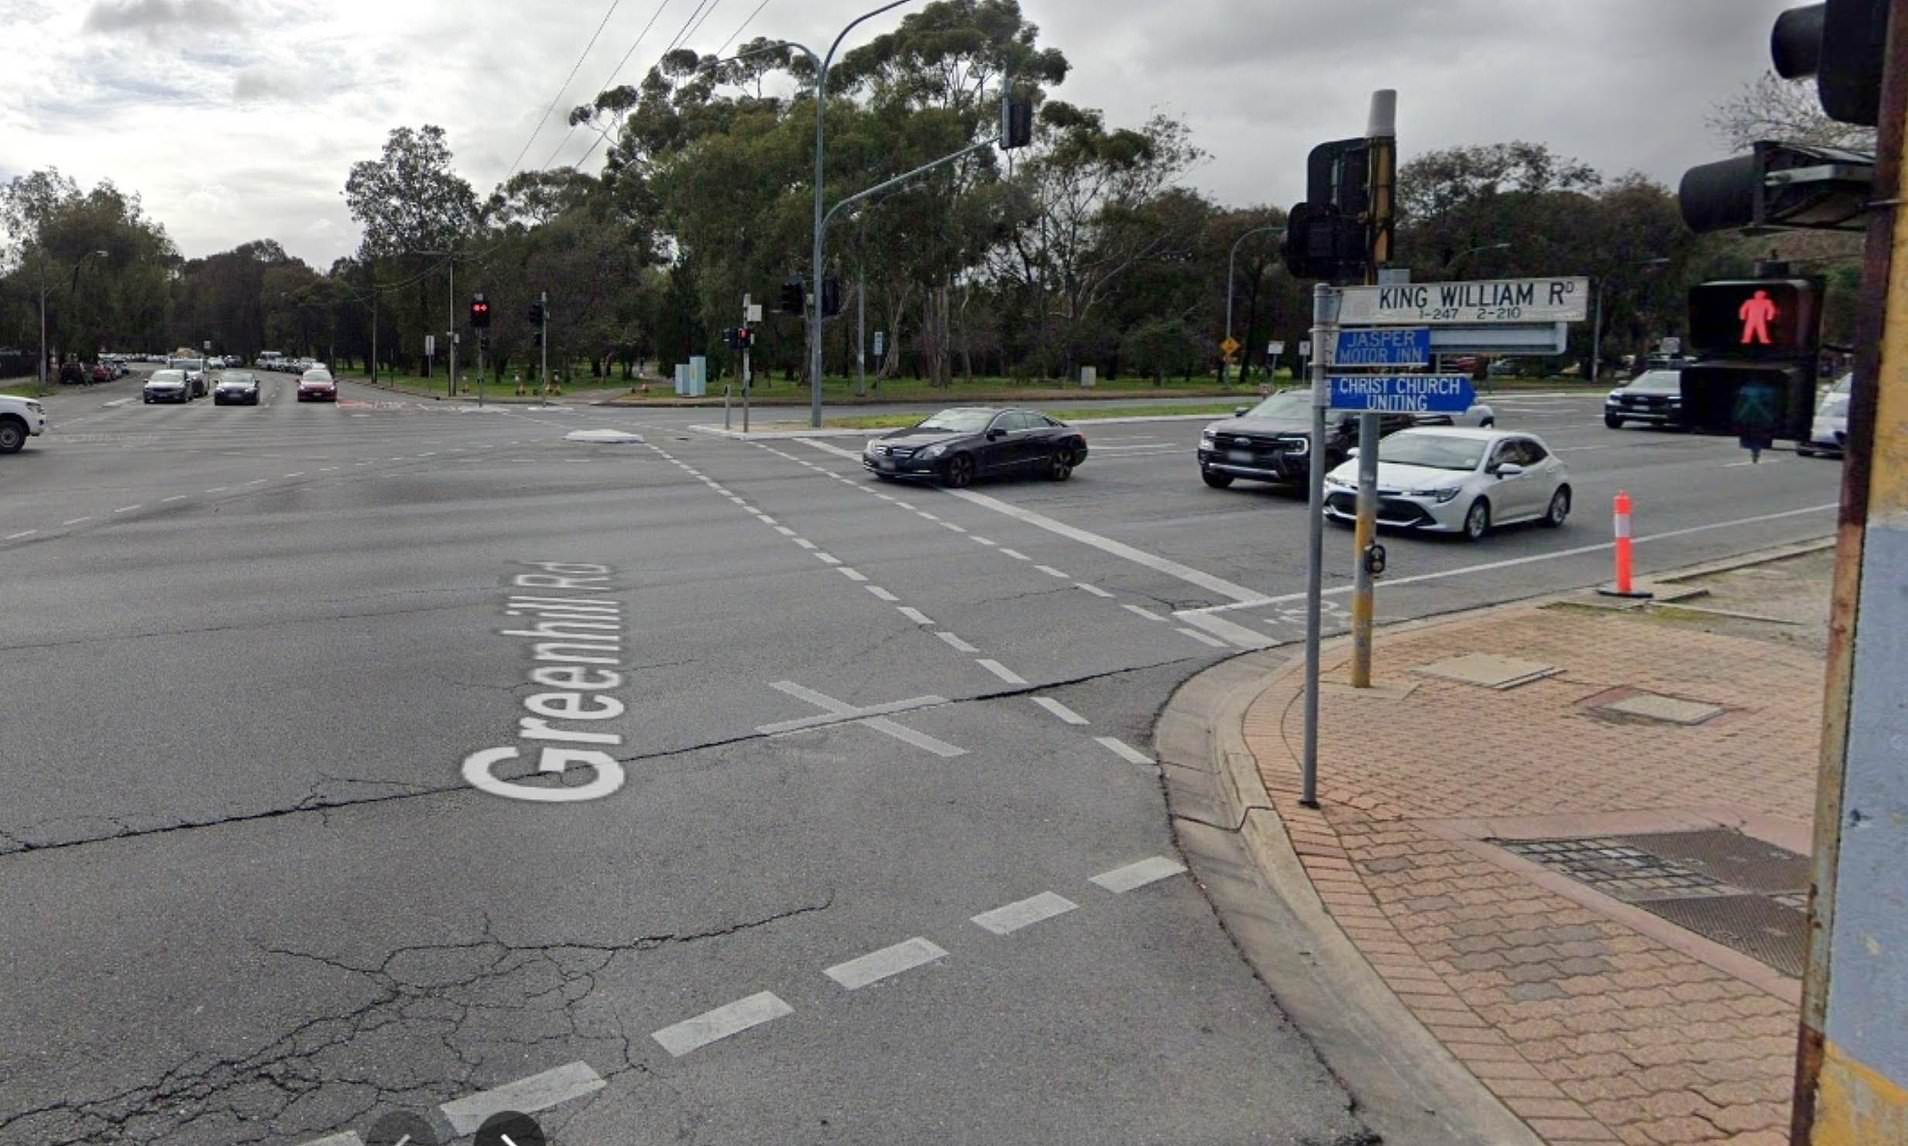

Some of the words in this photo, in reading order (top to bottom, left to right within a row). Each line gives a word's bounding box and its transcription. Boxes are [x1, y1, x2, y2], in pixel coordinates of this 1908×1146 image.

[1379, 286, 1428, 310] KING
[1440, 283, 1535, 307] WILLIAM
[1419, 308, 1459, 321] 1-247
[1476, 306, 1521, 320] 2-210
[1346, 331, 1416, 348] JASPER
[1340, 347, 1388, 363] MOTOR
[1395, 347, 1423, 363] INN
[1340, 378, 1389, 394] CHRIST
[1395, 377, 1460, 394] CHURCH
[1366, 394, 1428, 411] UNITING
